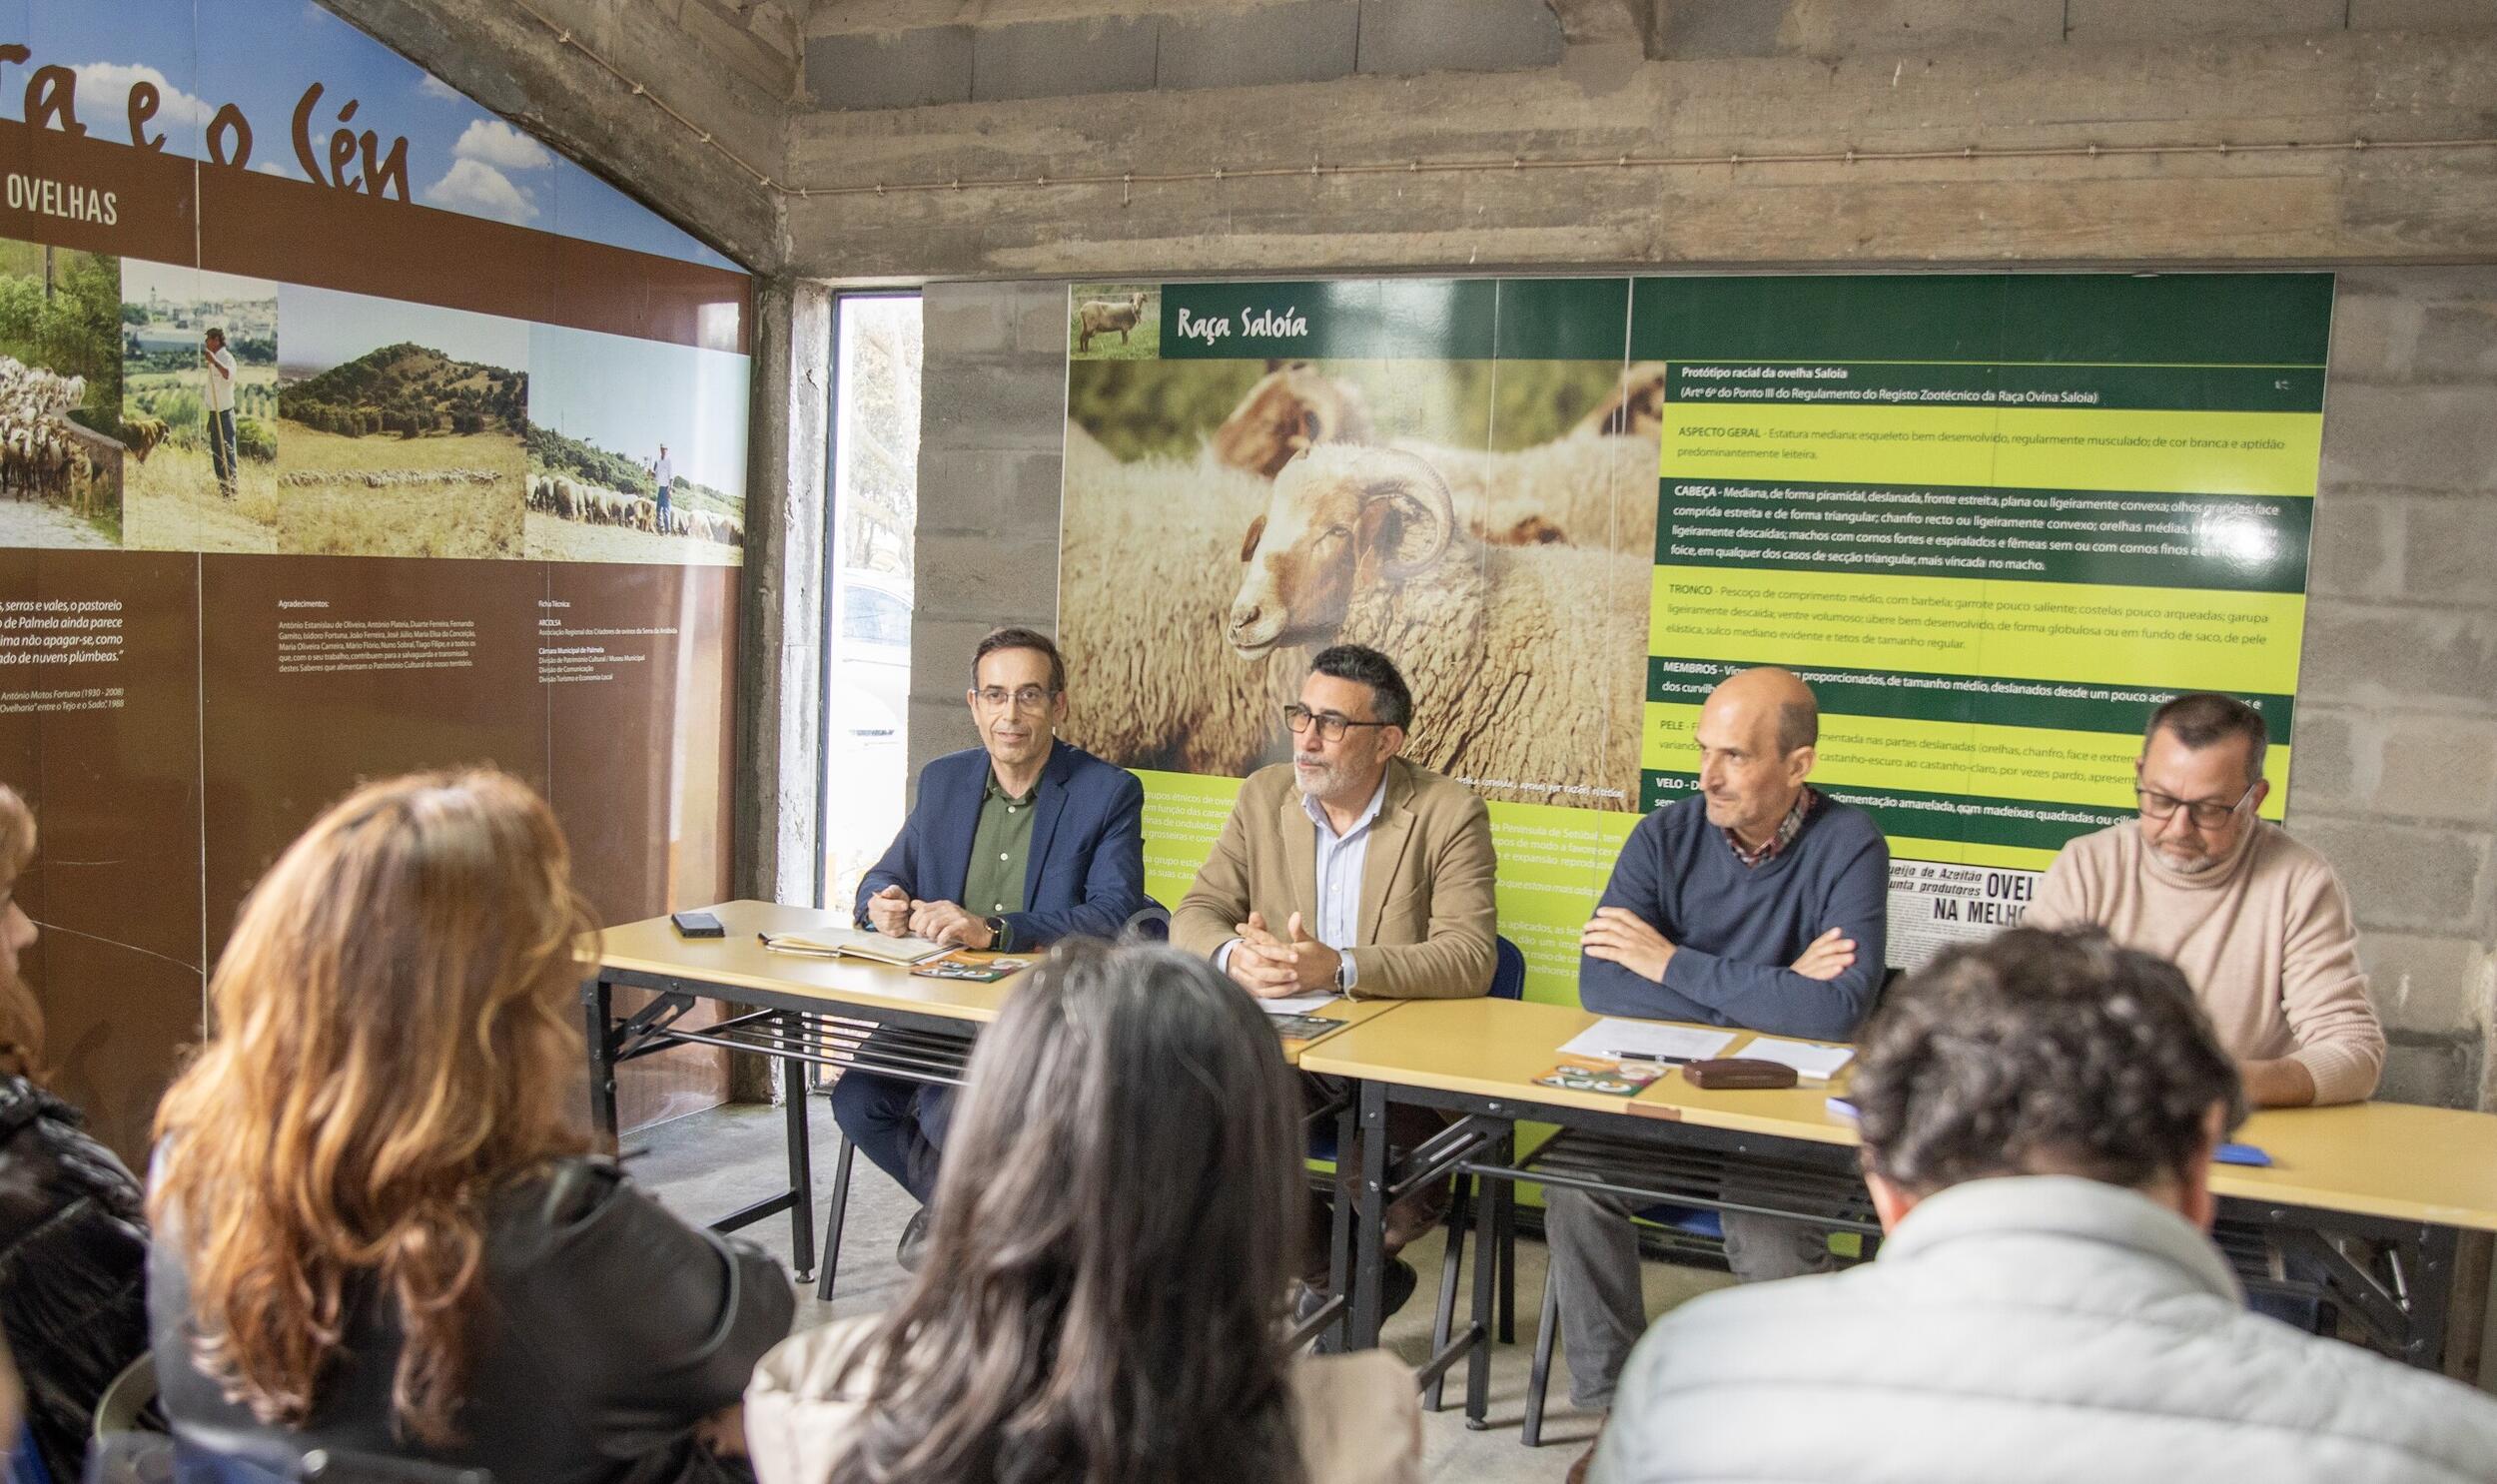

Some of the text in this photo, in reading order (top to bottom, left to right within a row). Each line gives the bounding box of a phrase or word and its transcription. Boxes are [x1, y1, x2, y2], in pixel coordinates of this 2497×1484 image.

[129, 82, 167, 151] e
[206, 103, 253, 169] o
[292, 82, 411, 203] Céu
[7, 174, 117, 225] OVELHAS
[1178, 308, 1231, 346] Raça
[1682, 366, 1848, 380] Protótipo racial da ovelha Saloia
[1718, 385, 1731, 398] do
[1733, 385, 1763, 398] Ponto
[1765, 386, 1774, 398] III
[1776, 386, 1790, 398] do
[1792, 386, 1860, 401] Regulamento
[1862, 387, 1877, 399] do
[1879, 387, 1918, 402] Registo
[1920, 387, 1980, 400] Zootécnico
[1982, 388, 1996, 401] da
[1998, 388, 2024, 403] Raça
[2026, 389, 2059, 401] Ovina
[2061, 389, 2098, 404] Saloia)
[1674, 484, 1716, 500] CABEÇA
[1769, 487, 1783, 500] de
[1785, 487, 1815, 501] forma
[1924, 492, 1956, 505] fronte
[2001, 494, 2031, 509] plana
[2033, 498, 2048, 508] ou
[2050, 495, 2118, 511] ligeiramente
[2170, 499, 2201, 512] olhos
[2255, 502, 2279, 515] face
[1673, 504, 1722, 519] comprida
[1724, 506, 1762, 519] estreita
[1764, 509, 1772, 519] e
[1774, 507, 1788, 519] de
[1790, 507, 1822, 521] forma
[1881, 511, 1923, 524] chanfro
[1925, 514, 1954, 525] recto
[1956, 516, 1972, 526] ou
[1973, 514, 2045, 529] ligeiramente
[2099, 519, 2142, 532] orelhas
[1672, 524, 1733, 539] ligeiramente
[1789, 529, 1829, 542] machos
[1831, 532, 1854, 543] com
[1856, 533, 1892, 544] cornos
[1894, 532, 1924, 545] fortes
[1926, 536, 1933, 545] e
[1935, 534, 1996, 549] espiralados
[1998, 538, 2006, 548] e
[2007, 536, 2048, 549] fêmeas
[2049, 540, 2073, 550] sem
[2075, 541, 2090, 551] ou
[2091, 542, 2117, 552] com
[2119, 543, 2158, 553] cornos
[2160, 541, 2188, 554] finos
[1697, 546, 1714, 556] em
[1715, 545, 1760, 560] qualquer
[1762, 546, 1780, 559] dos
[1782, 550, 1810, 560] casos
[1812, 548, 1826, 561] de
[1828, 549, 1863, 564] secção
[1918, 552, 1943, 565] mais
[1945, 553, 1987, 567] vincada
[1988, 557, 2003, 567] no
[5, 601, 34, 611] serras
[36, 601, 42, 611] e
[43, 599, 70, 612] vales,
[70, 601, 77, 611] o
[78, 599, 122, 613] pastoreio
[279, 600, 330, 609] Agradecimentos:
[4, 616, 123, 630] de Palmela ainda parece
[21, 634, 42, 646] não
[43, 635, 94, 648] apagar-se,
[96, 635, 123, 644] como
[18, 652, 31, 664] de
[33, 654, 68, 663] nuvens
[1663, 661, 1718, 675] MEMBROS
[1, 691, 30, 700] António
[53, 690, 80, 699] Fortuna
[1887, 674, 1901, 687] de
[1903, 676, 1951, 690] tamanho
[1991, 679, 2052, 695] deslanados
[2054, 683, 2087, 697] desde
[2089, 688, 2108, 699] um
[2110, 689, 2147, 702] pouco
[1660, 720, 1684, 730] PELE
[1655, 777, 1684, 789] VELO
[1888, 865, 1982, 882] ueijo de Azeitão
[1919, 882, 1982, 897] produtores
[1987, 873, 2033, 901] OVEL
[1934, 898, 1959, 921] NA
